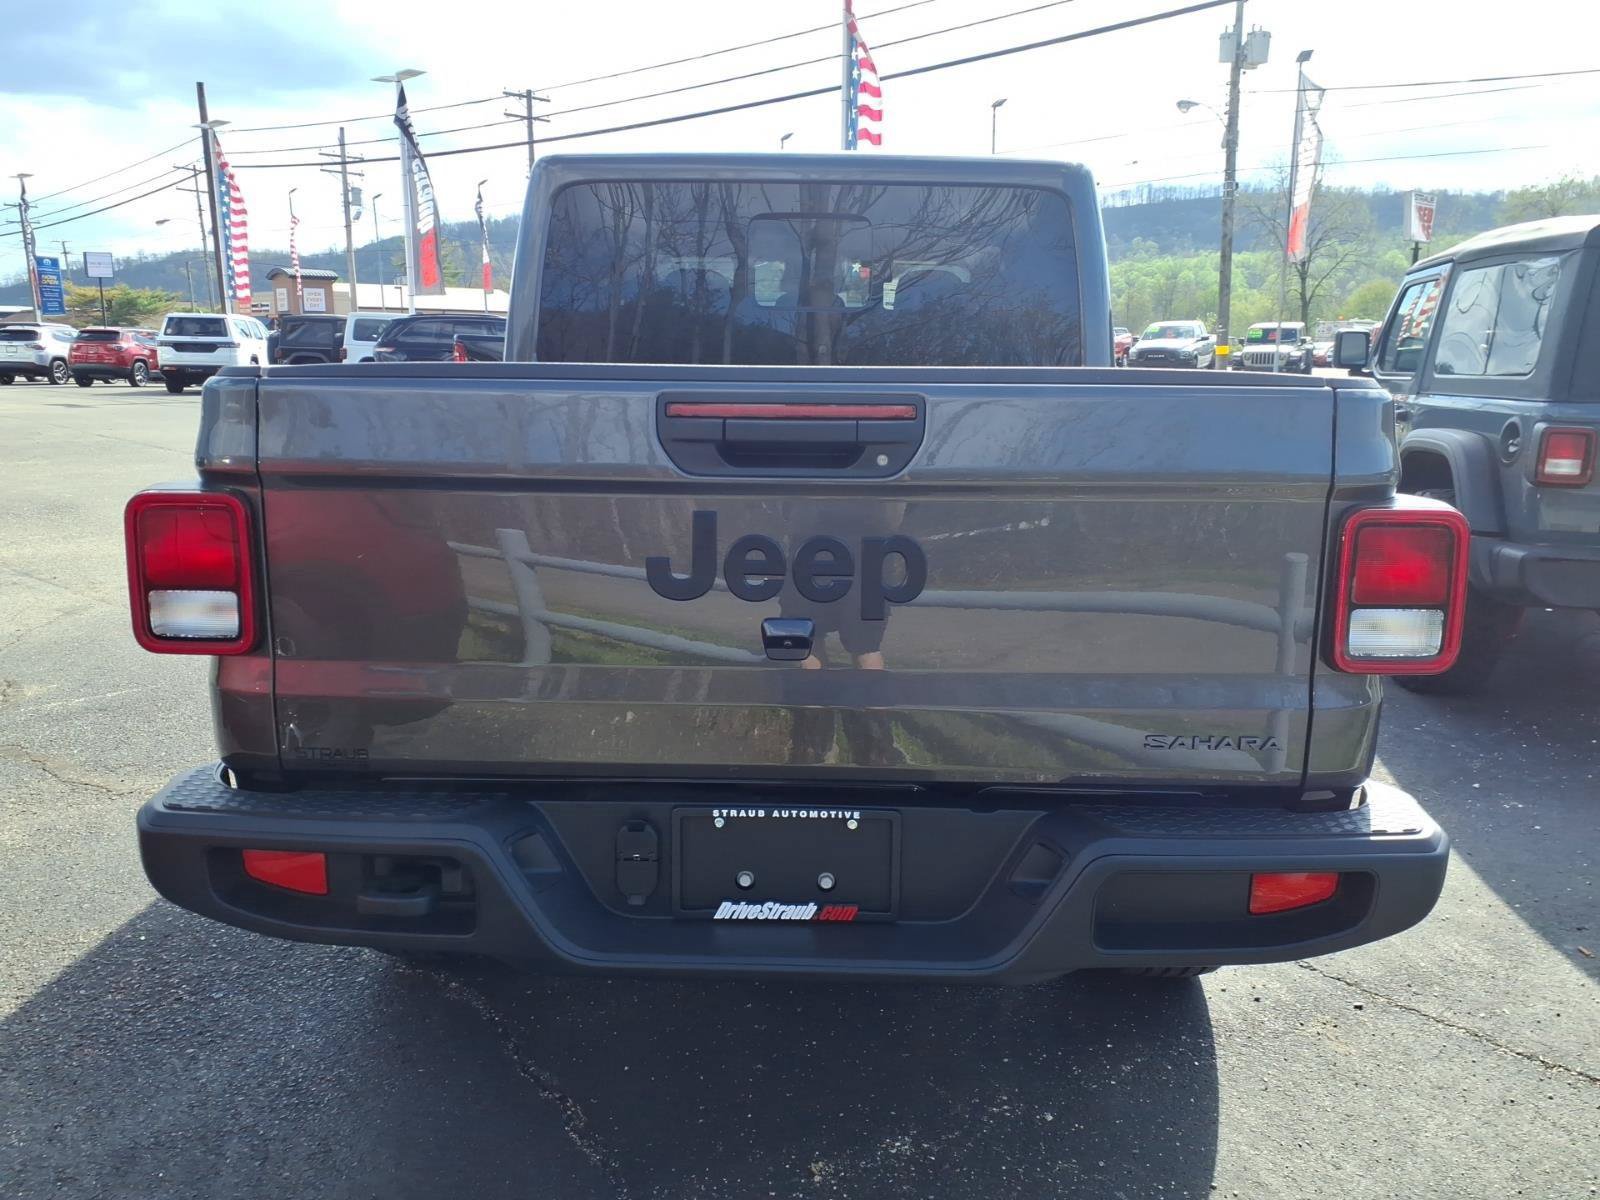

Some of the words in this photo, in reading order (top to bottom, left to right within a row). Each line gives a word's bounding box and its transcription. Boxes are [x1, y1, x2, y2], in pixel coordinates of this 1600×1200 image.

[645, 510, 928, 621] Jeep
[1143, 733, 1283, 751] SAHARA
[295, 747, 369, 760] STRAUB
[712, 809, 766, 818] STRAUB
[772, 809, 861, 819] AUTOMOTIVE
